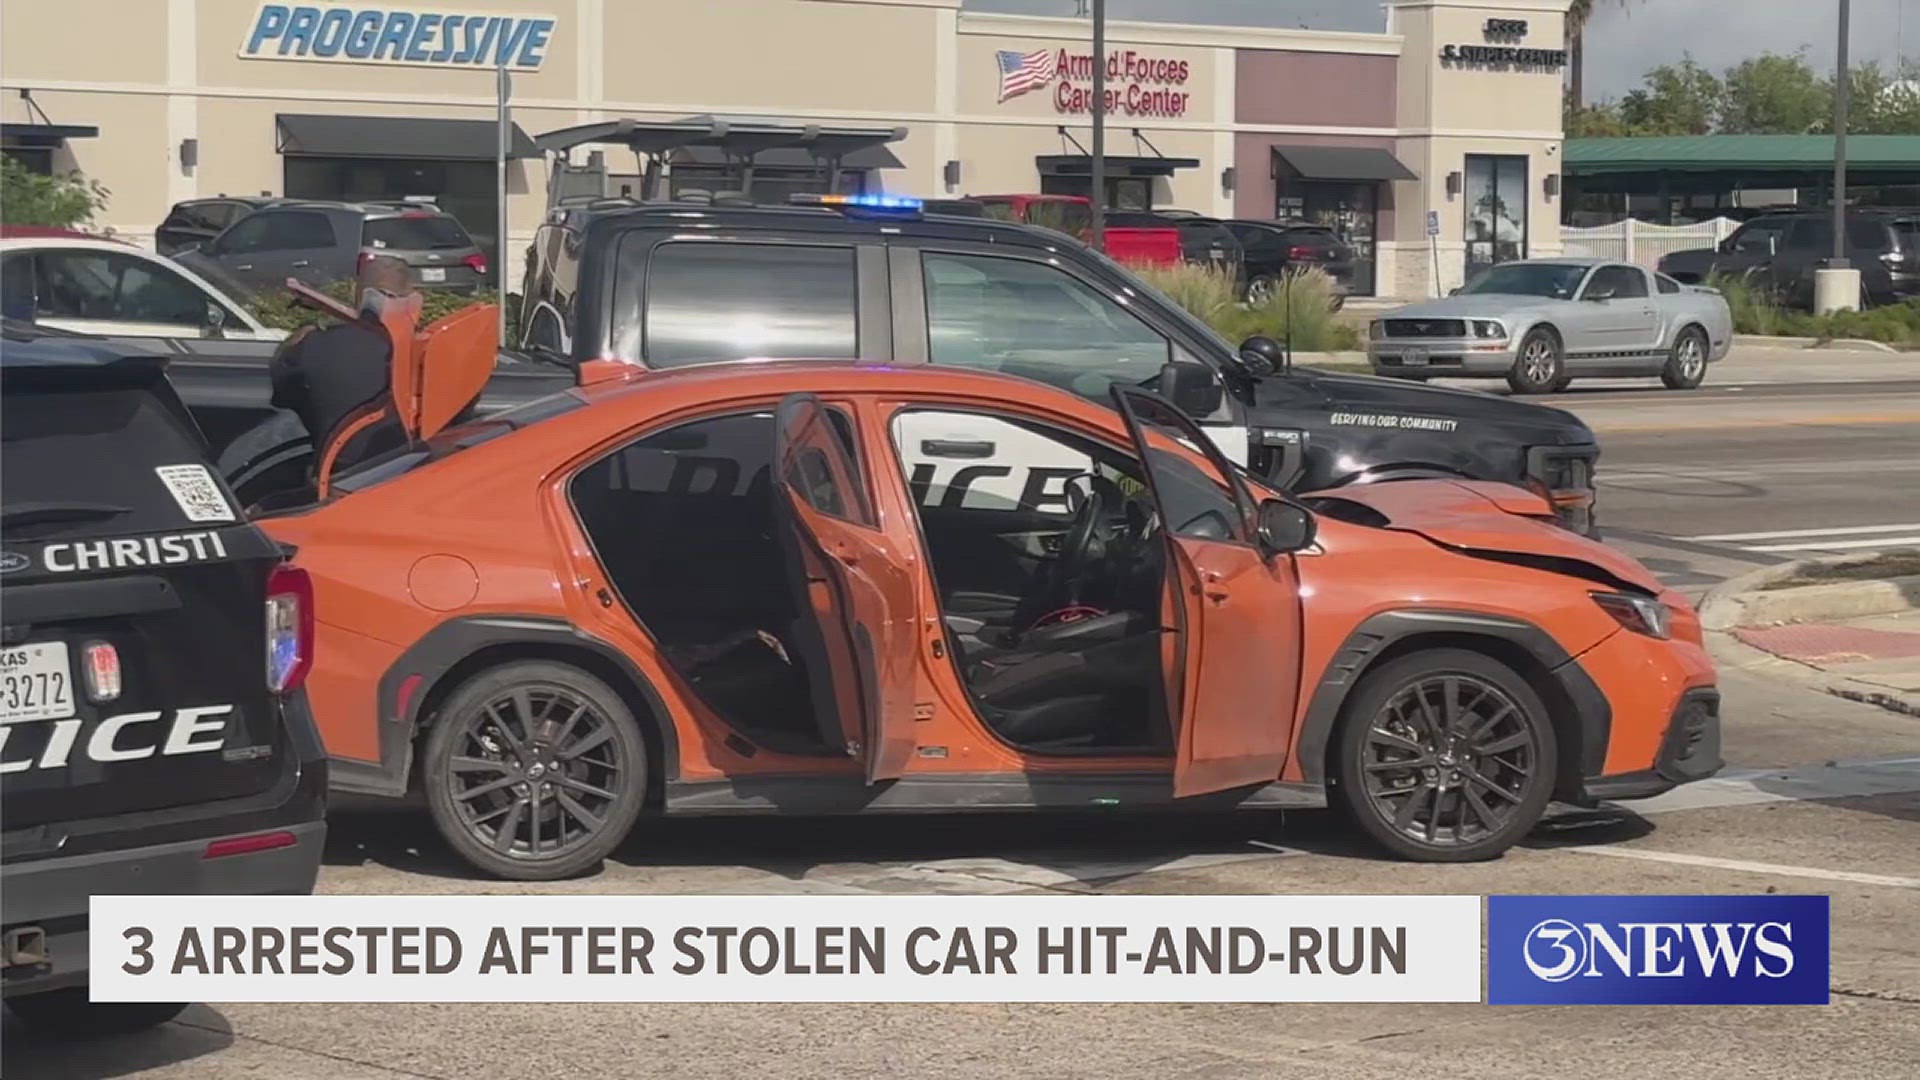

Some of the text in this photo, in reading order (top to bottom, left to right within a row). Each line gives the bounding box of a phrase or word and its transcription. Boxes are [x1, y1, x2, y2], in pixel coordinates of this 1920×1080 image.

[247, 5, 555, 66] PROGRESSIVE
[1056, 48, 1189, 80] Armd Forces
[1058, 81, 1190, 112] Carer Center
[1330, 412, 1458, 431] SERVING OUR COMMUNITY
[43, 531, 228, 572] CHRISTI
